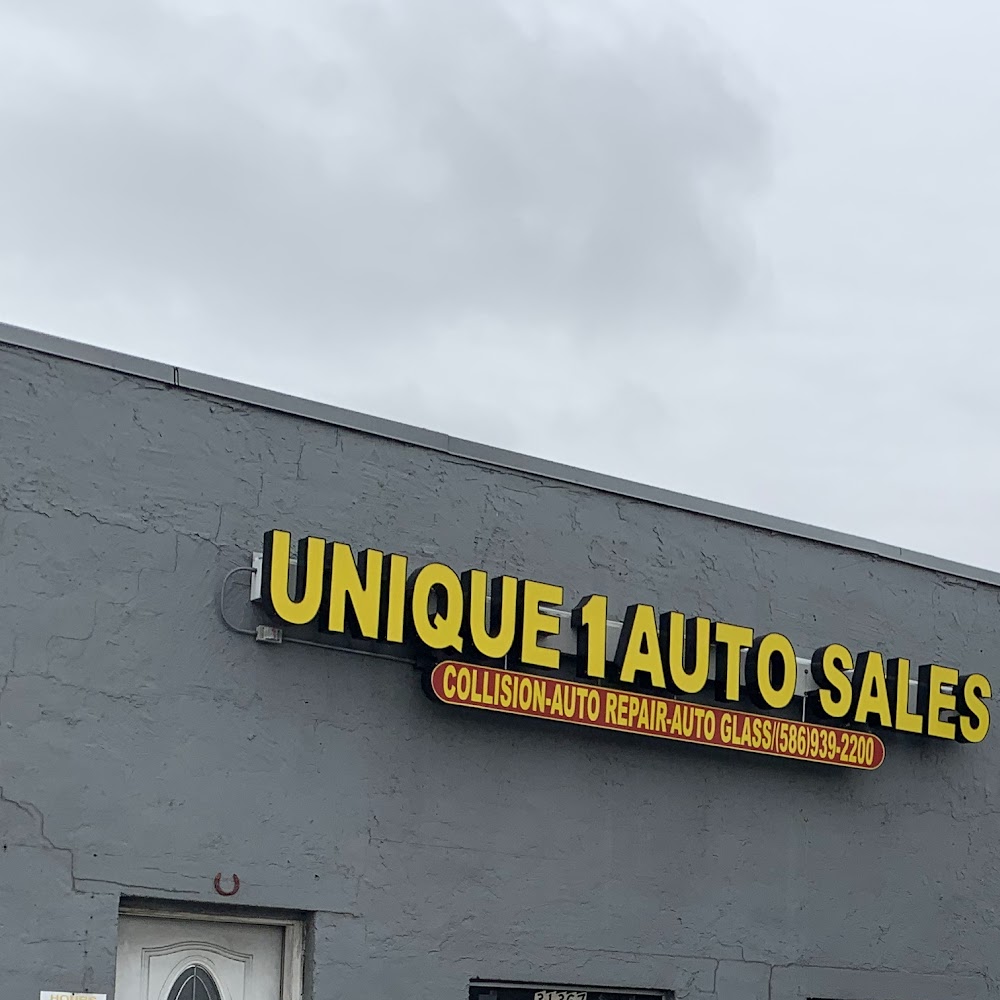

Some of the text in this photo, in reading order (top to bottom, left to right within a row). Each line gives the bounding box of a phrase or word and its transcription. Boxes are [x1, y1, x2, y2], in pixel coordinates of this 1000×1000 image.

[269, 528, 993, 744] UNIQUE 1 AUTO SALES
[442, 665, 600, 722] COLLISION-AUTO
[605, 691, 716, 741] REPAIR-AUTO
